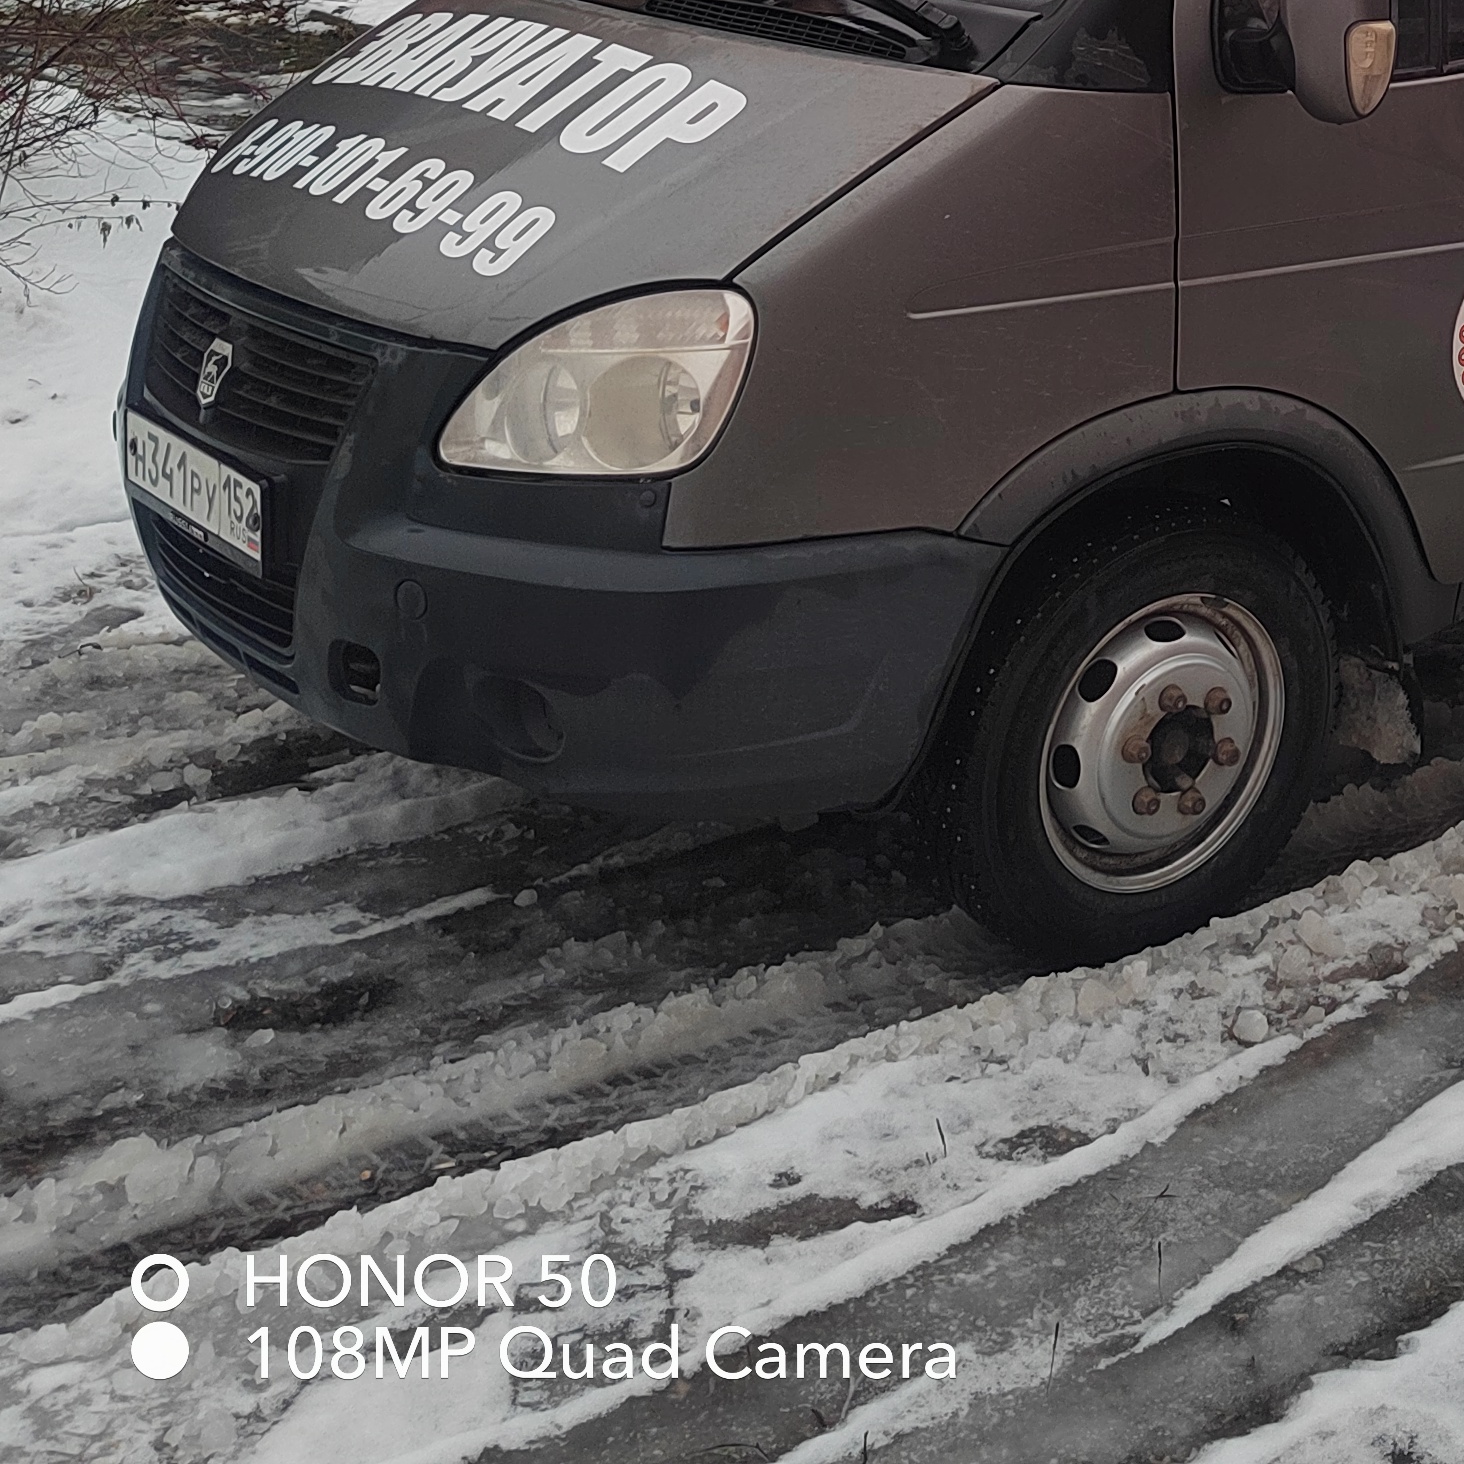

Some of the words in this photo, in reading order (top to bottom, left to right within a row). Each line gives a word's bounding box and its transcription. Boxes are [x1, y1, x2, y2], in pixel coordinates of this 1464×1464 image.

[311, 12, 748, 174] ЭВАКУАТОР
[210, 118, 556, 277] 8-910-101-69-99
[222, 474, 261, 533] 152
[229, 520, 247, 544] RUS
